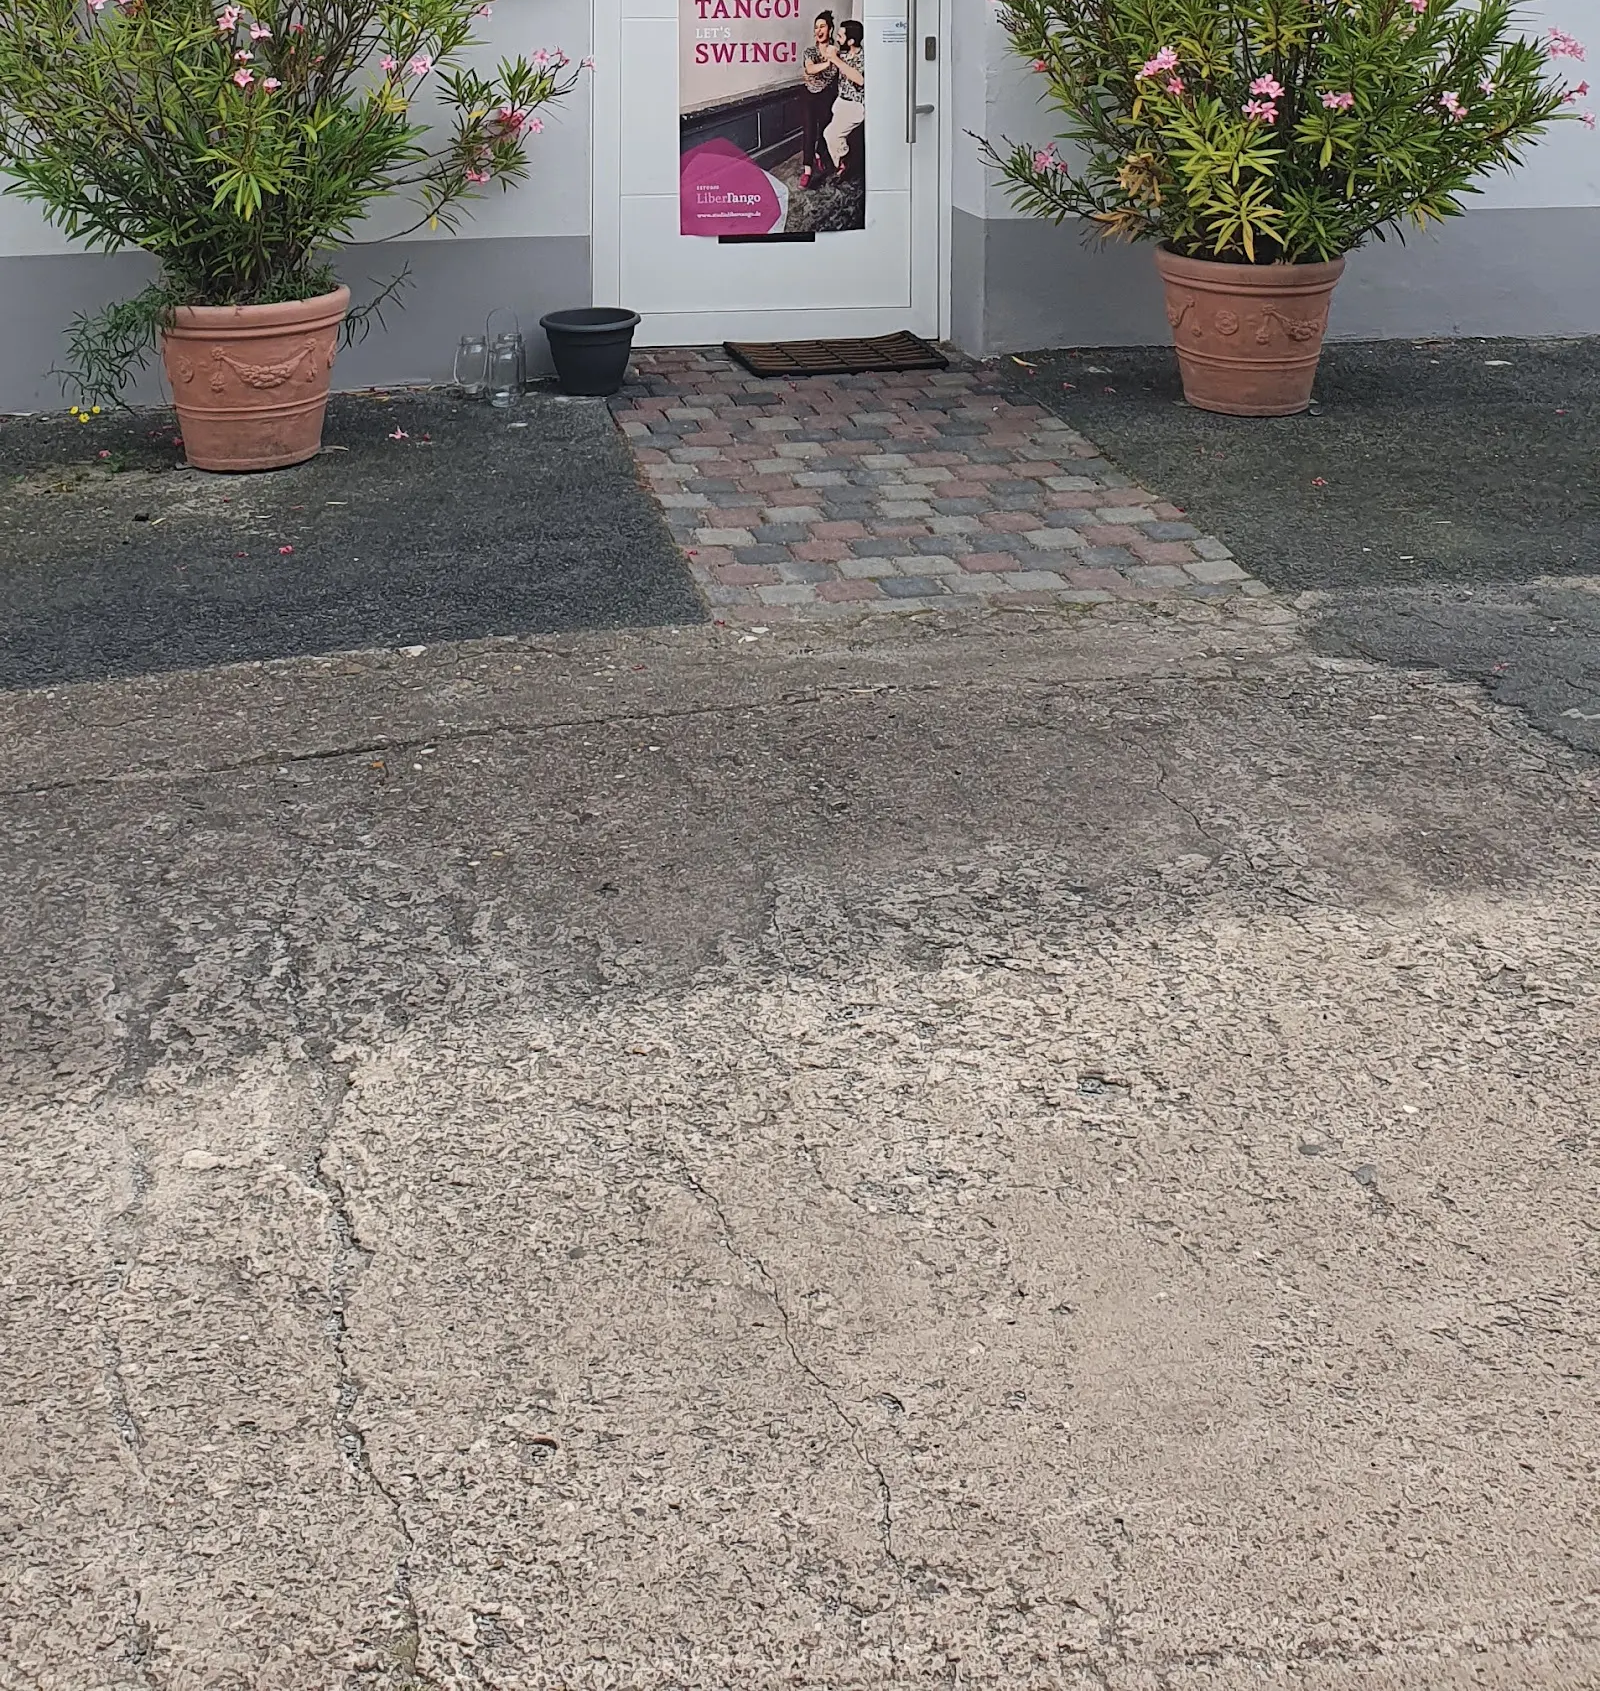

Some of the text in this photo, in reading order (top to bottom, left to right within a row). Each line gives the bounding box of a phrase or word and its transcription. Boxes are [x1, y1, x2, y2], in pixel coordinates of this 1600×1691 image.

[695, 25, 731, 39] LET'S
[695, 42, 797, 64] SWING!
[696, 192, 762, 205] LiberTango
